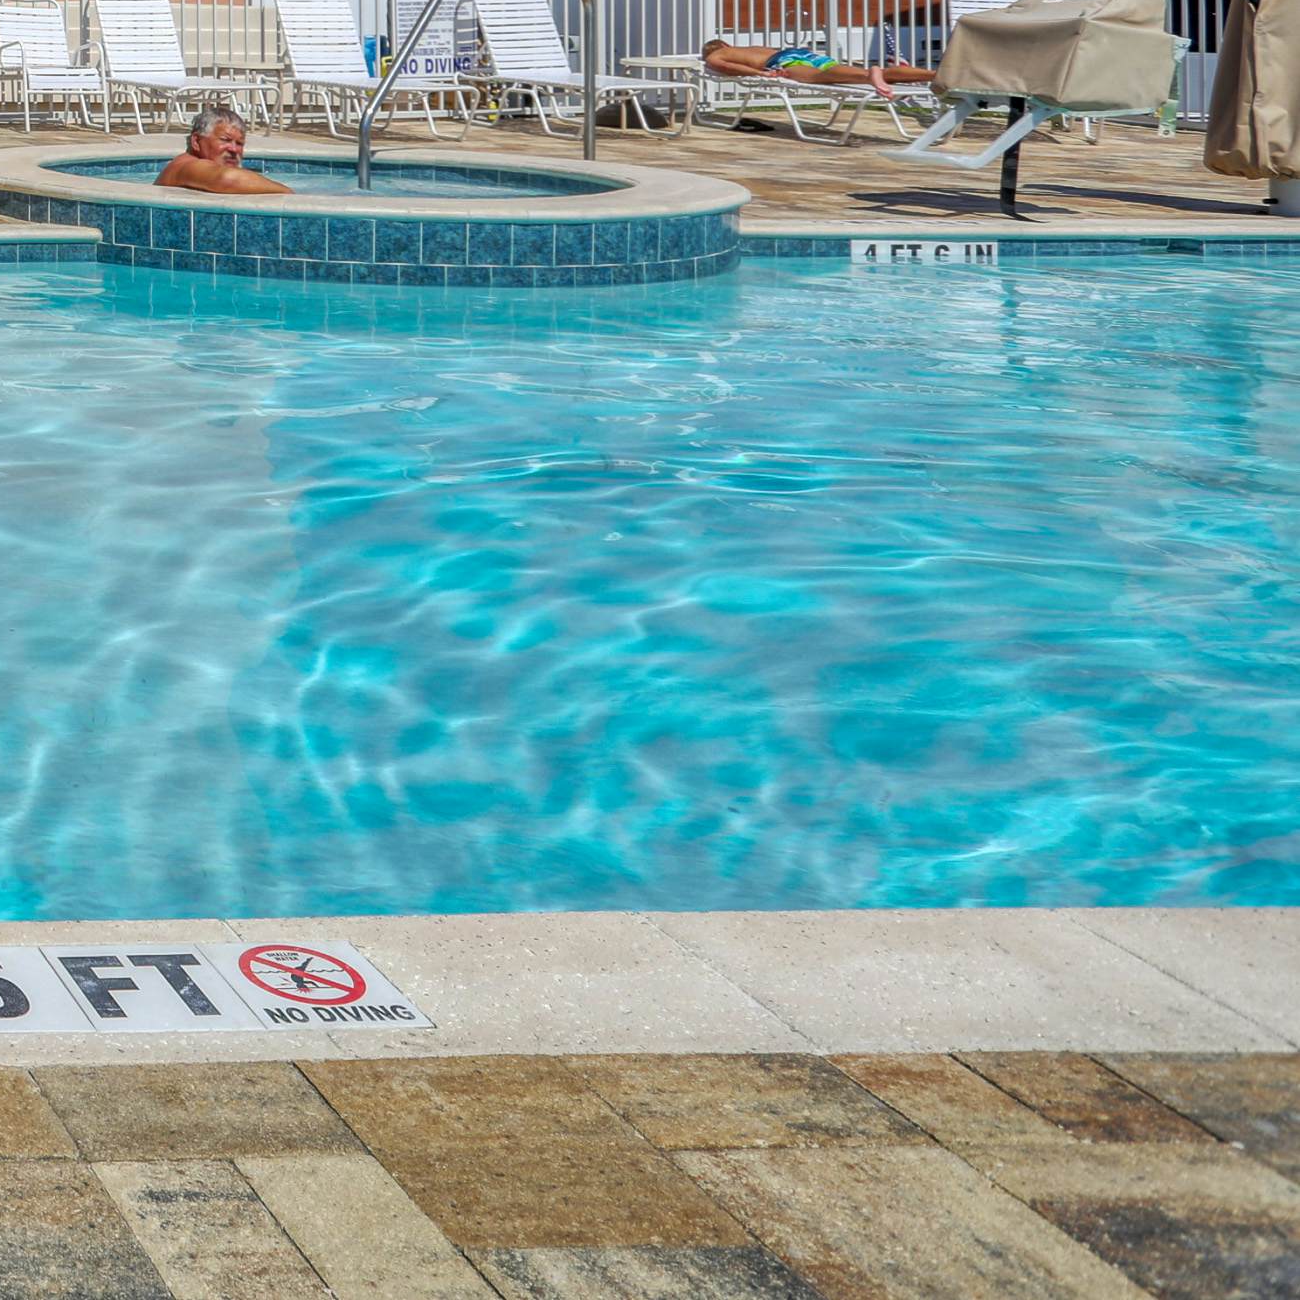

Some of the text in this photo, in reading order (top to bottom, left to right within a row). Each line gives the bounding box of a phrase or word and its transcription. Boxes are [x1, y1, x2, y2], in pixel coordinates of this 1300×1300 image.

[425, 57, 471, 74] DIVING
[57, 953, 222, 1019] FT
[263, 1003, 416, 1024] NO DIVING
